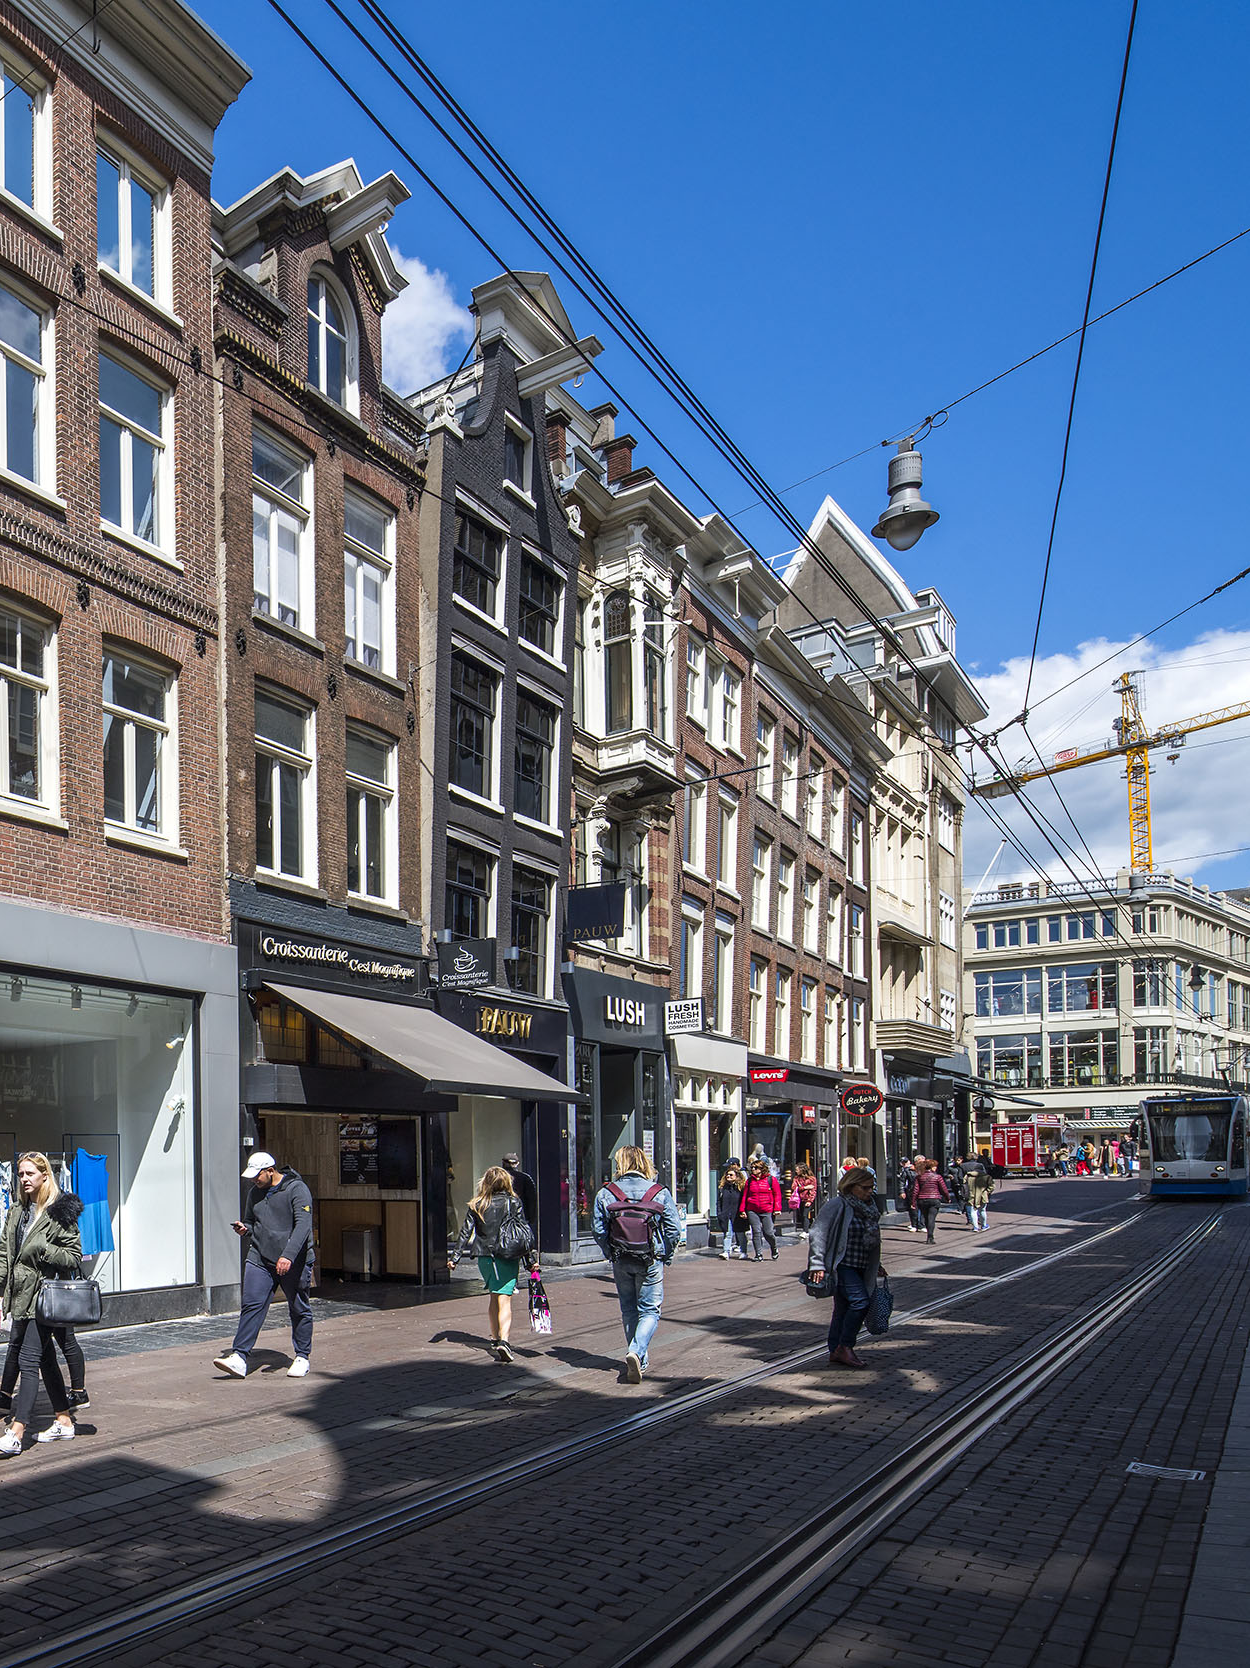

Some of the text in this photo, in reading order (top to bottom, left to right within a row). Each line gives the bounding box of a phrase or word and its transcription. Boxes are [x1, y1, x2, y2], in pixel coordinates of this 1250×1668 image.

[573, 924, 618, 939] PAUW
[262, 936, 349, 963] Croissanterie
[441, 970, 489, 981] Croissanterie
[606, 995, 646, 1026] LUSH
[667, 1002, 700, 1013] LUSH
[667, 1010, 700, 1021] FRESH
[480, 1006, 534, 1038] PAUW
[667, 1018, 700, 1026] HANDMADE
[667, 1023, 700, 1031] COSMETICS
[846, 1095, 879, 1107] Bakery
